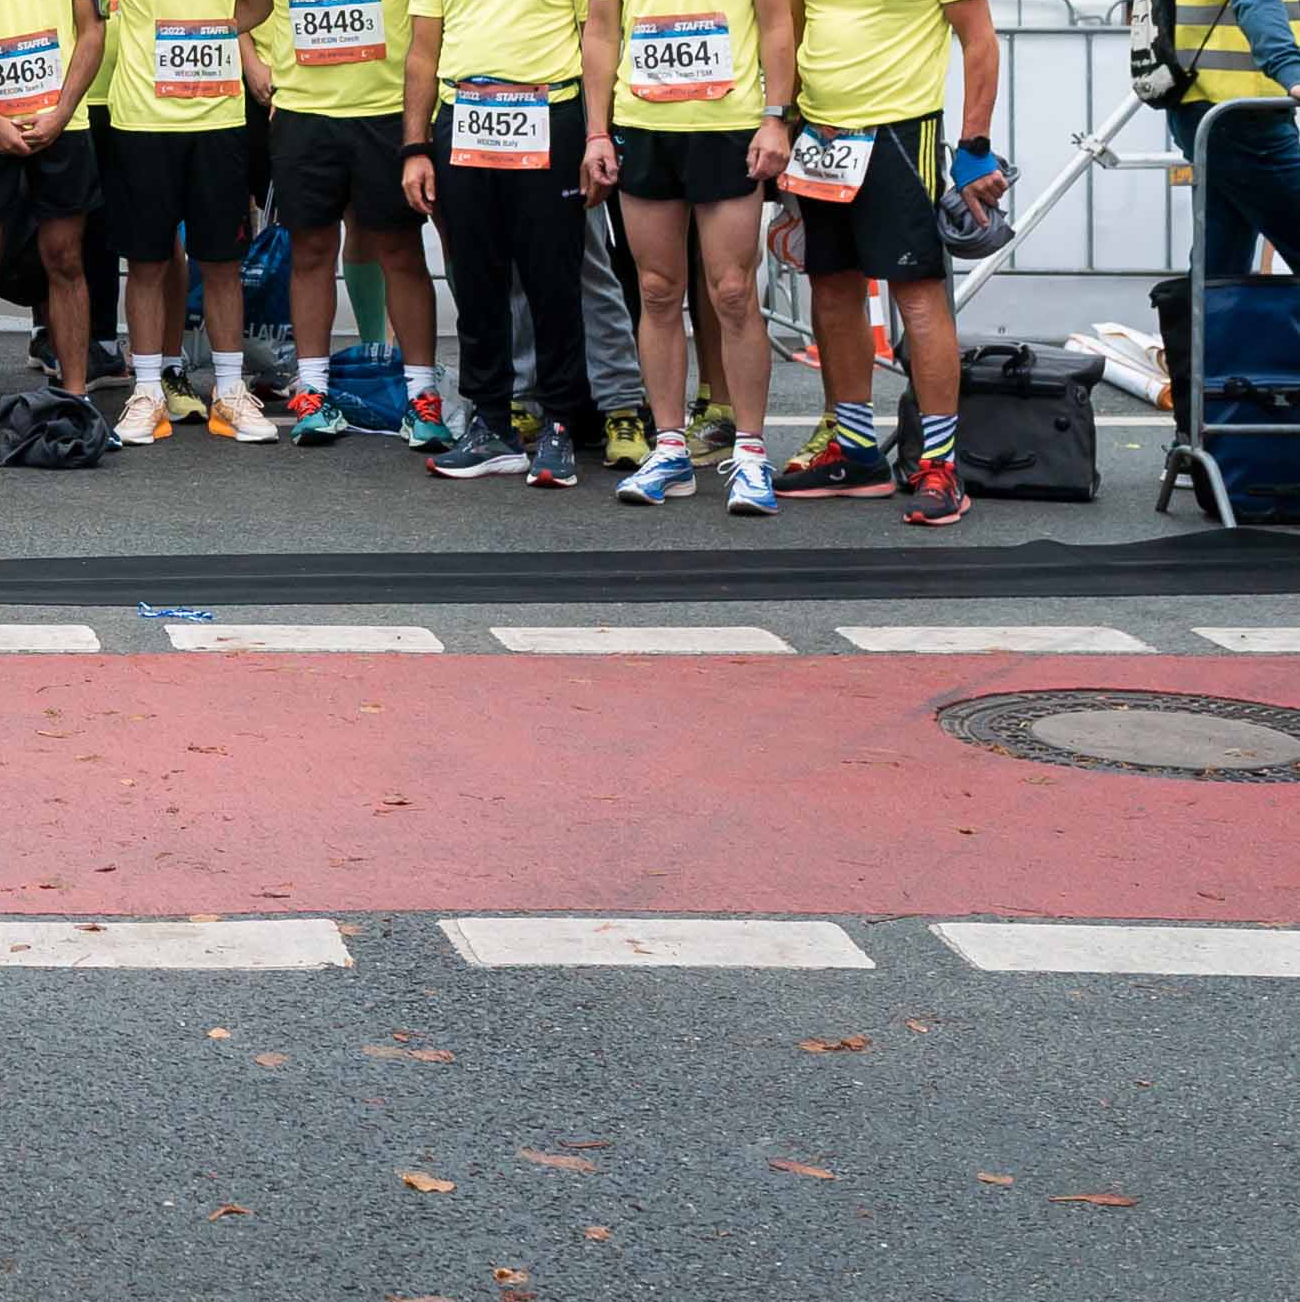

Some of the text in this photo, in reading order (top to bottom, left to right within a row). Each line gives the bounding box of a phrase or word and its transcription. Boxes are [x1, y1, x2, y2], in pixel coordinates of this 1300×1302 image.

[303, 9, 365, 36] 8448
[673, 20, 715, 32] STAFFEL
[17, 37, 51, 49] STAFFEL
[644, 41, 710, 69] 8464
[169, 44, 223, 68] 8461
[496, 92, 536, 101] STAFFEL
[468, 110, 528, 136] 8452
